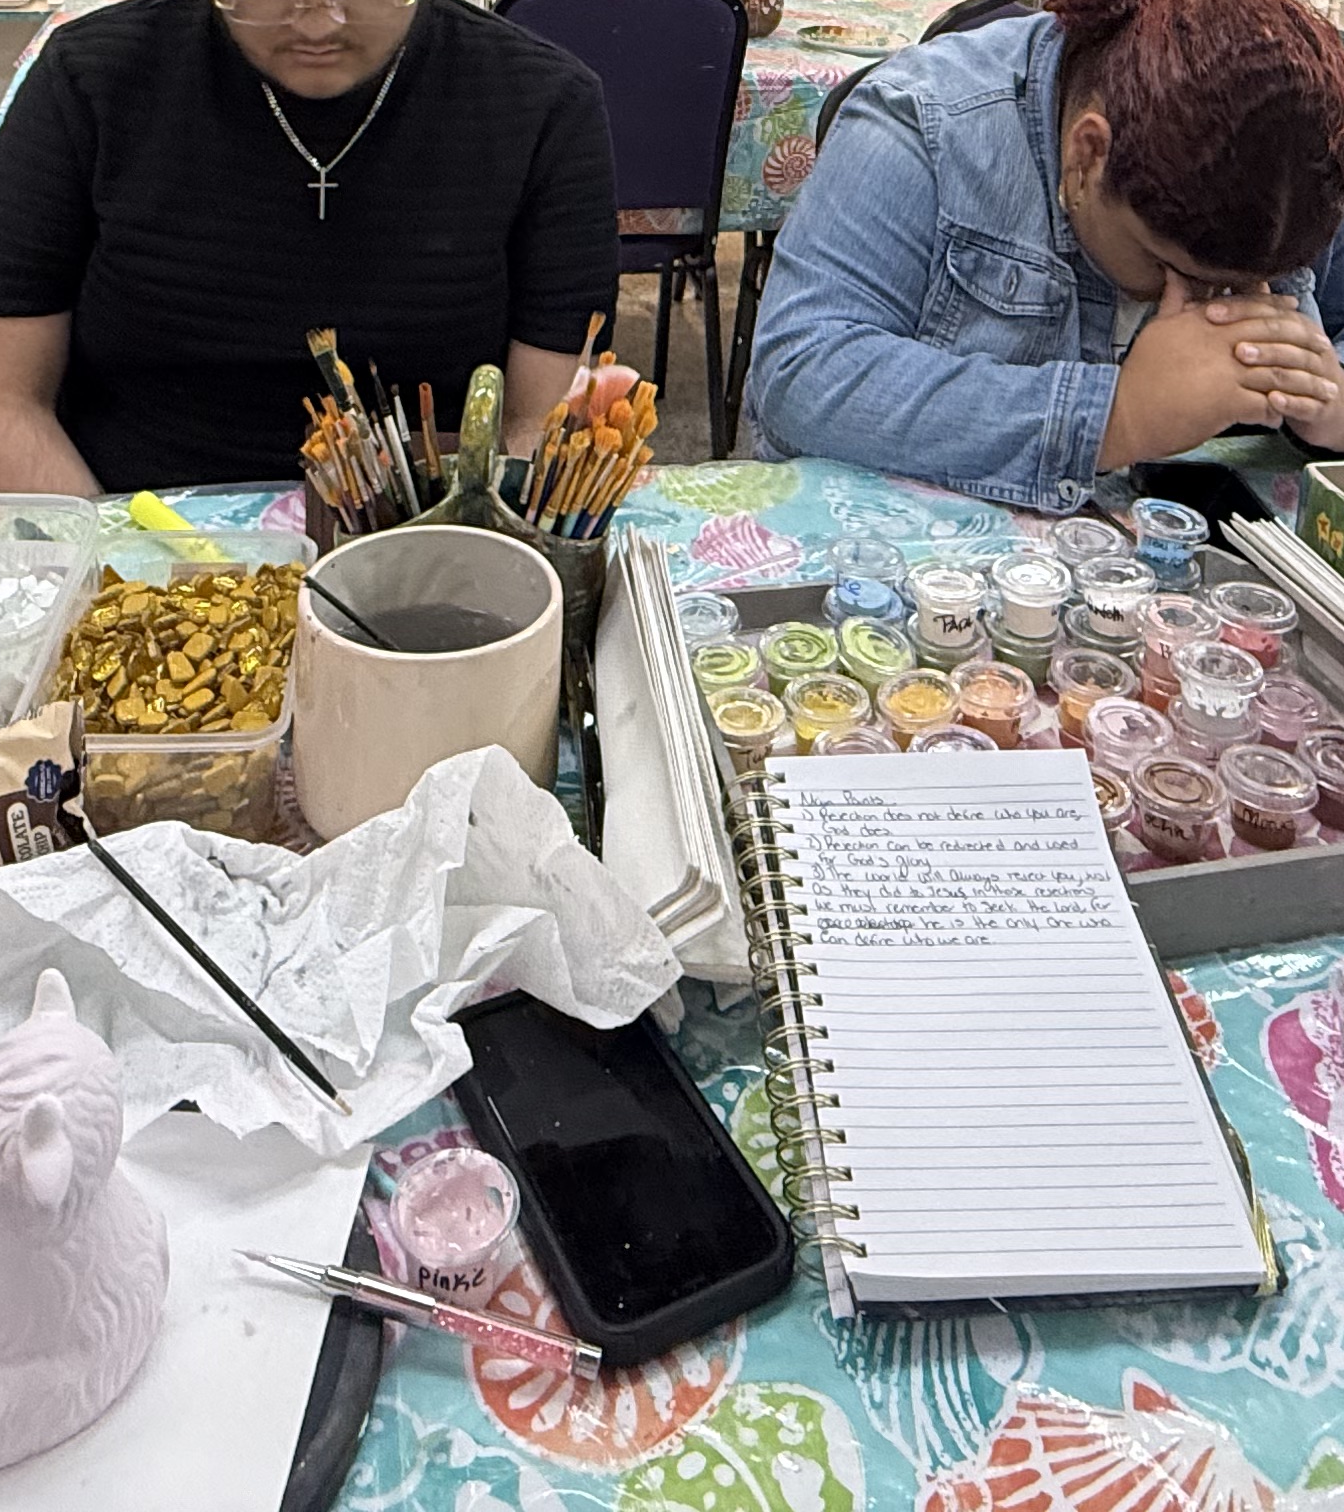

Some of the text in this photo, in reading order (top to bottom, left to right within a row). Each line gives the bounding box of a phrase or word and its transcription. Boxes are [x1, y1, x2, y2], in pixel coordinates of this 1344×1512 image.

[819, 807, 878, 822] Rejection
[883, 807, 912, 821] does
[919, 810, 941, 820] not
[947, 805, 984, 821] define
[1026, 807, 1050, 822] you
[822, 820, 849, 835] God
[823, 834, 879, 851] Rejection
[915, 838, 934, 850] be
[1014, 839, 1040, 852] and
[1045, 838, 1079, 851] used
[865, 869, 907, 882] world
[918, 869, 944, 884] will
[1007, 871, 1047, 883] reject
[841, 883, 875, 910] they
[879, 884, 902, 898] did
[909, 884, 923, 898] to
[839, 901, 877, 913] must
[886, 901, 955, 914] remember
[962, 901, 977, 914] to
[1027, 898, 1050, 913] the
[950, 918, 964, 929] is
[972, 915, 997, 928] the
[1006, 916, 1040, 932] only
[1046, 916, 1073, 929] one
[1079, 918, 1112, 929] who
[856, 932, 897, 947] define
[939, 935, 958, 946] we
